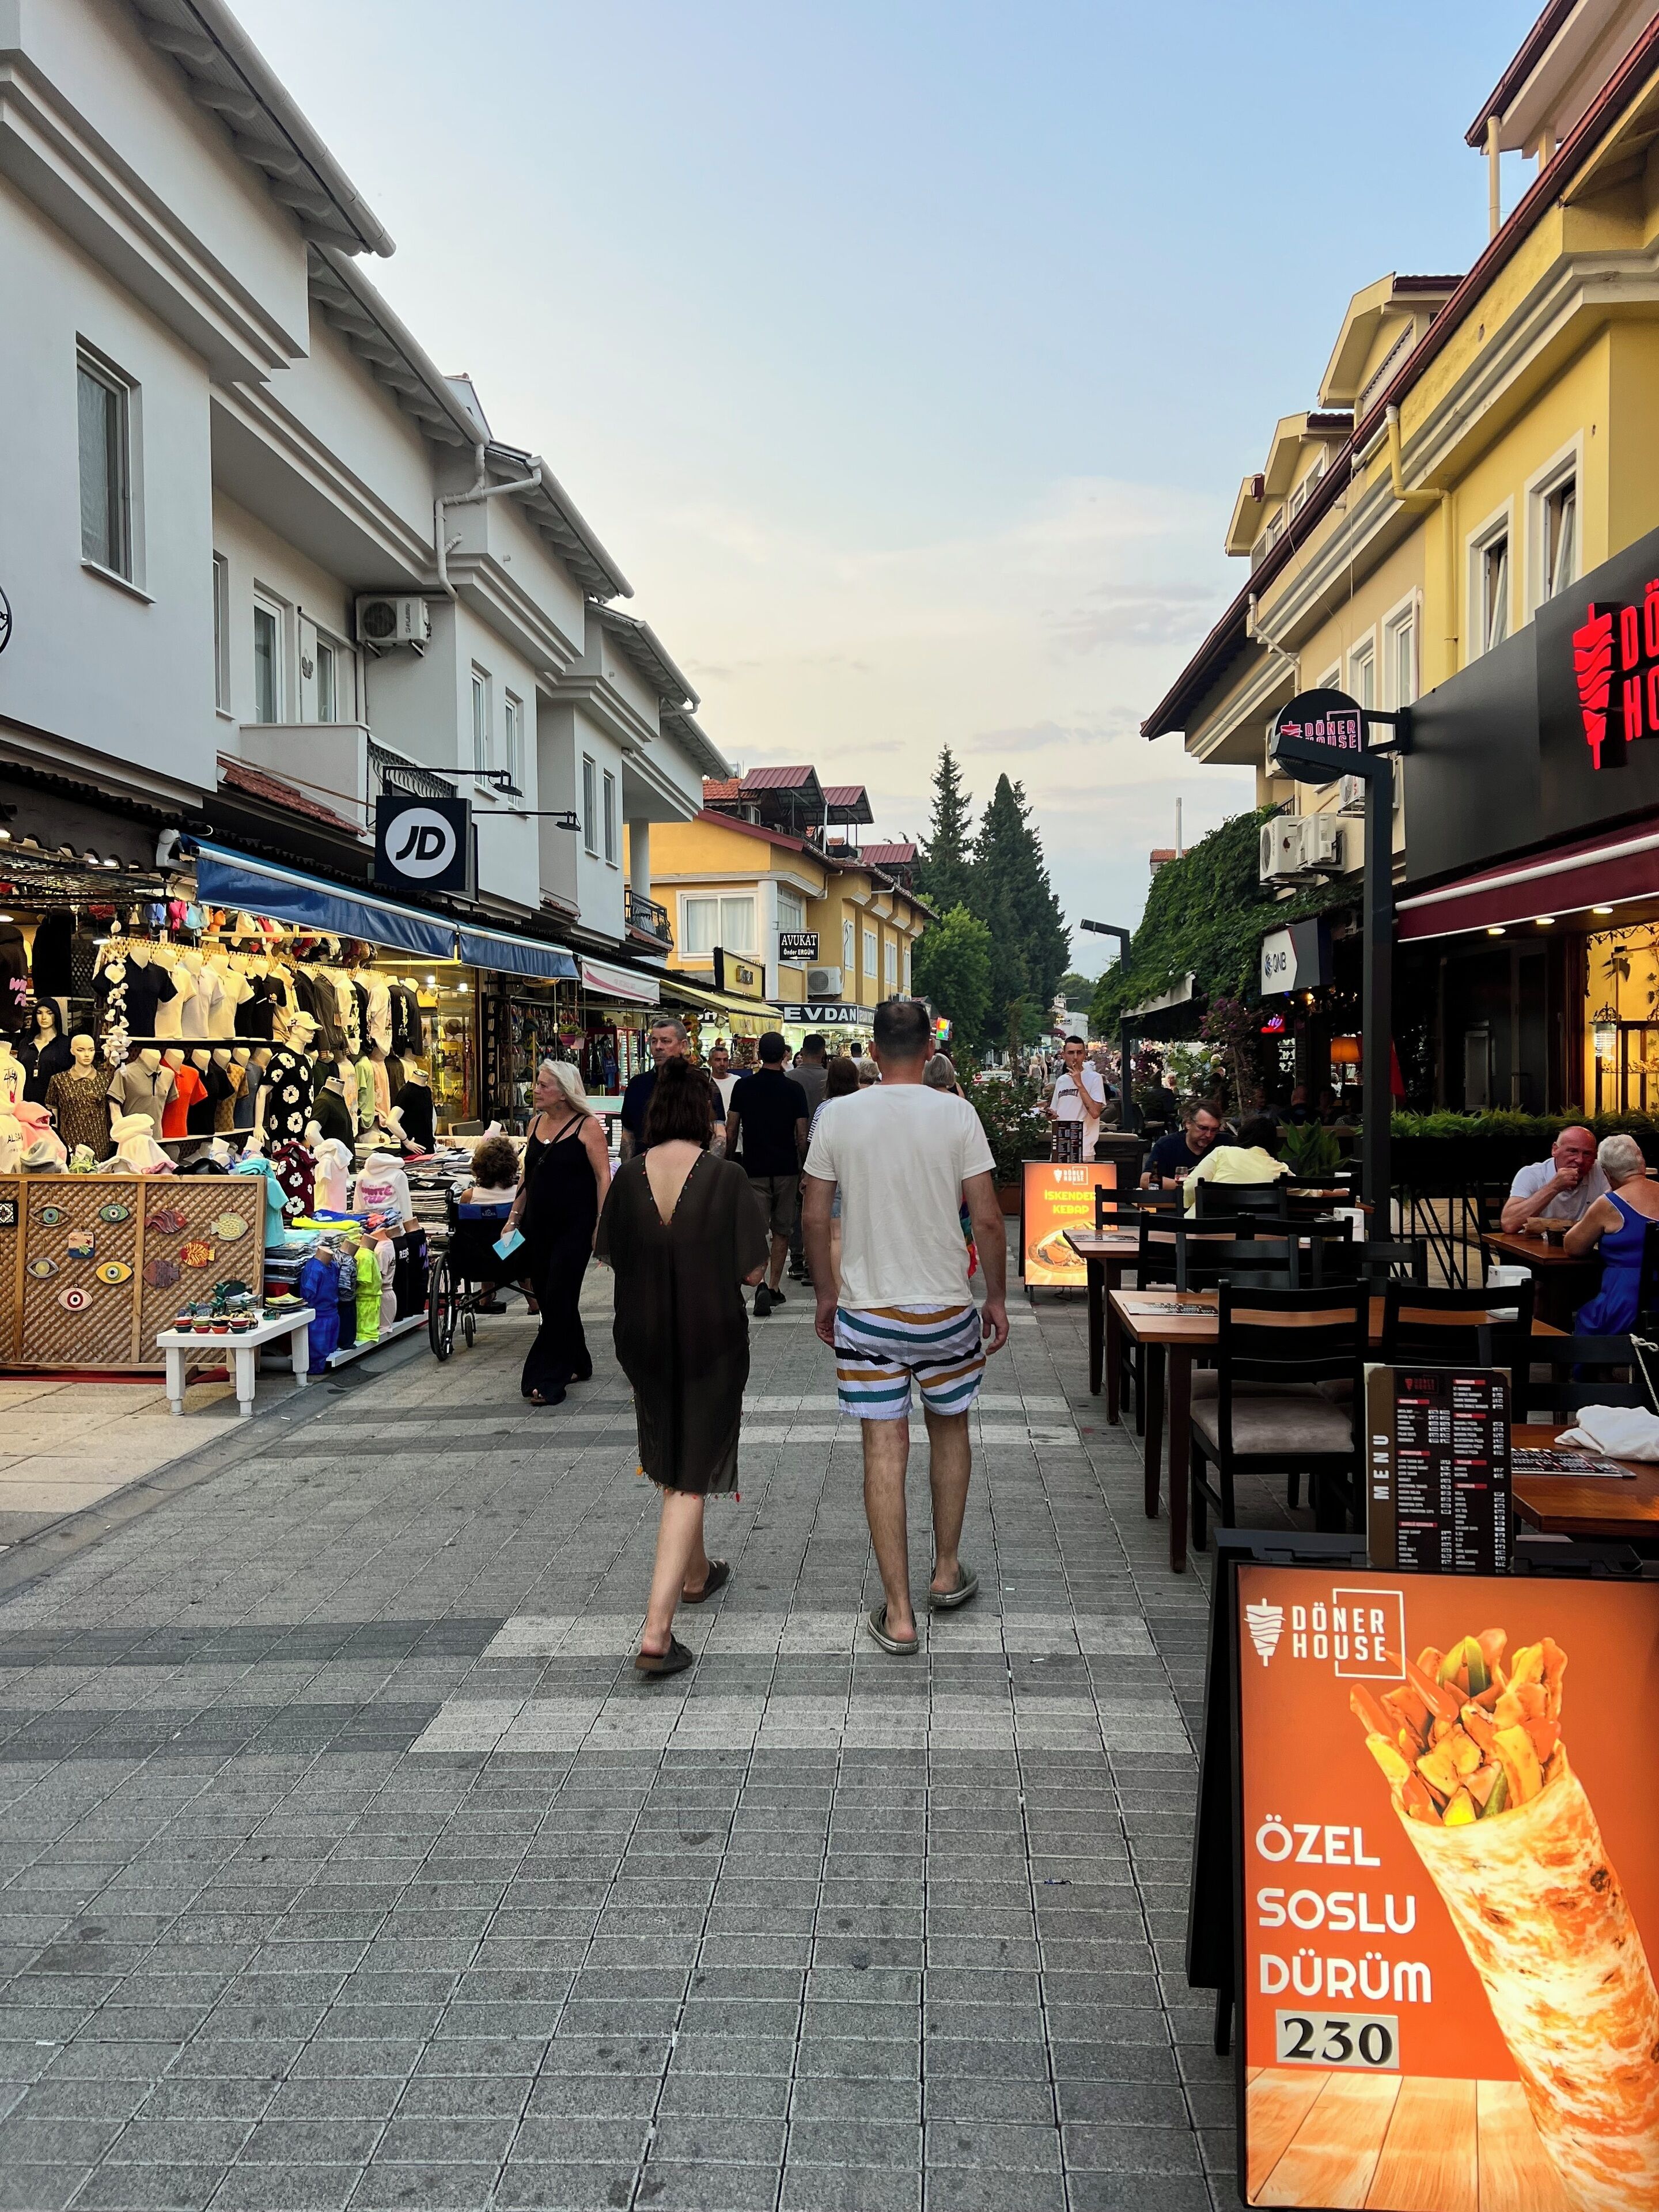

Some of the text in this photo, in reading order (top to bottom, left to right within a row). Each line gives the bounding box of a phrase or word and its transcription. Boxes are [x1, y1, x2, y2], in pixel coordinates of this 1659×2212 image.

[1305, 719, 1355, 737] DÖNER
[395, 825, 446, 861] JD
[781, 934, 817, 946] AVUKAT
[1273, 952, 1286, 973] QNB
[1052, 1205, 1090, 1214] KEBAP
[1373, 1435, 1389, 1500] MENU
[1292, 1602, 1384, 1634] DÖNER
[1293, 1633, 1387, 1661] HOUSE
[1256, 1813, 1381, 1867] ÖZEL
[1257, 1887, 1415, 1934] SOSLU
[1283, 2017, 1393, 2066] 230
